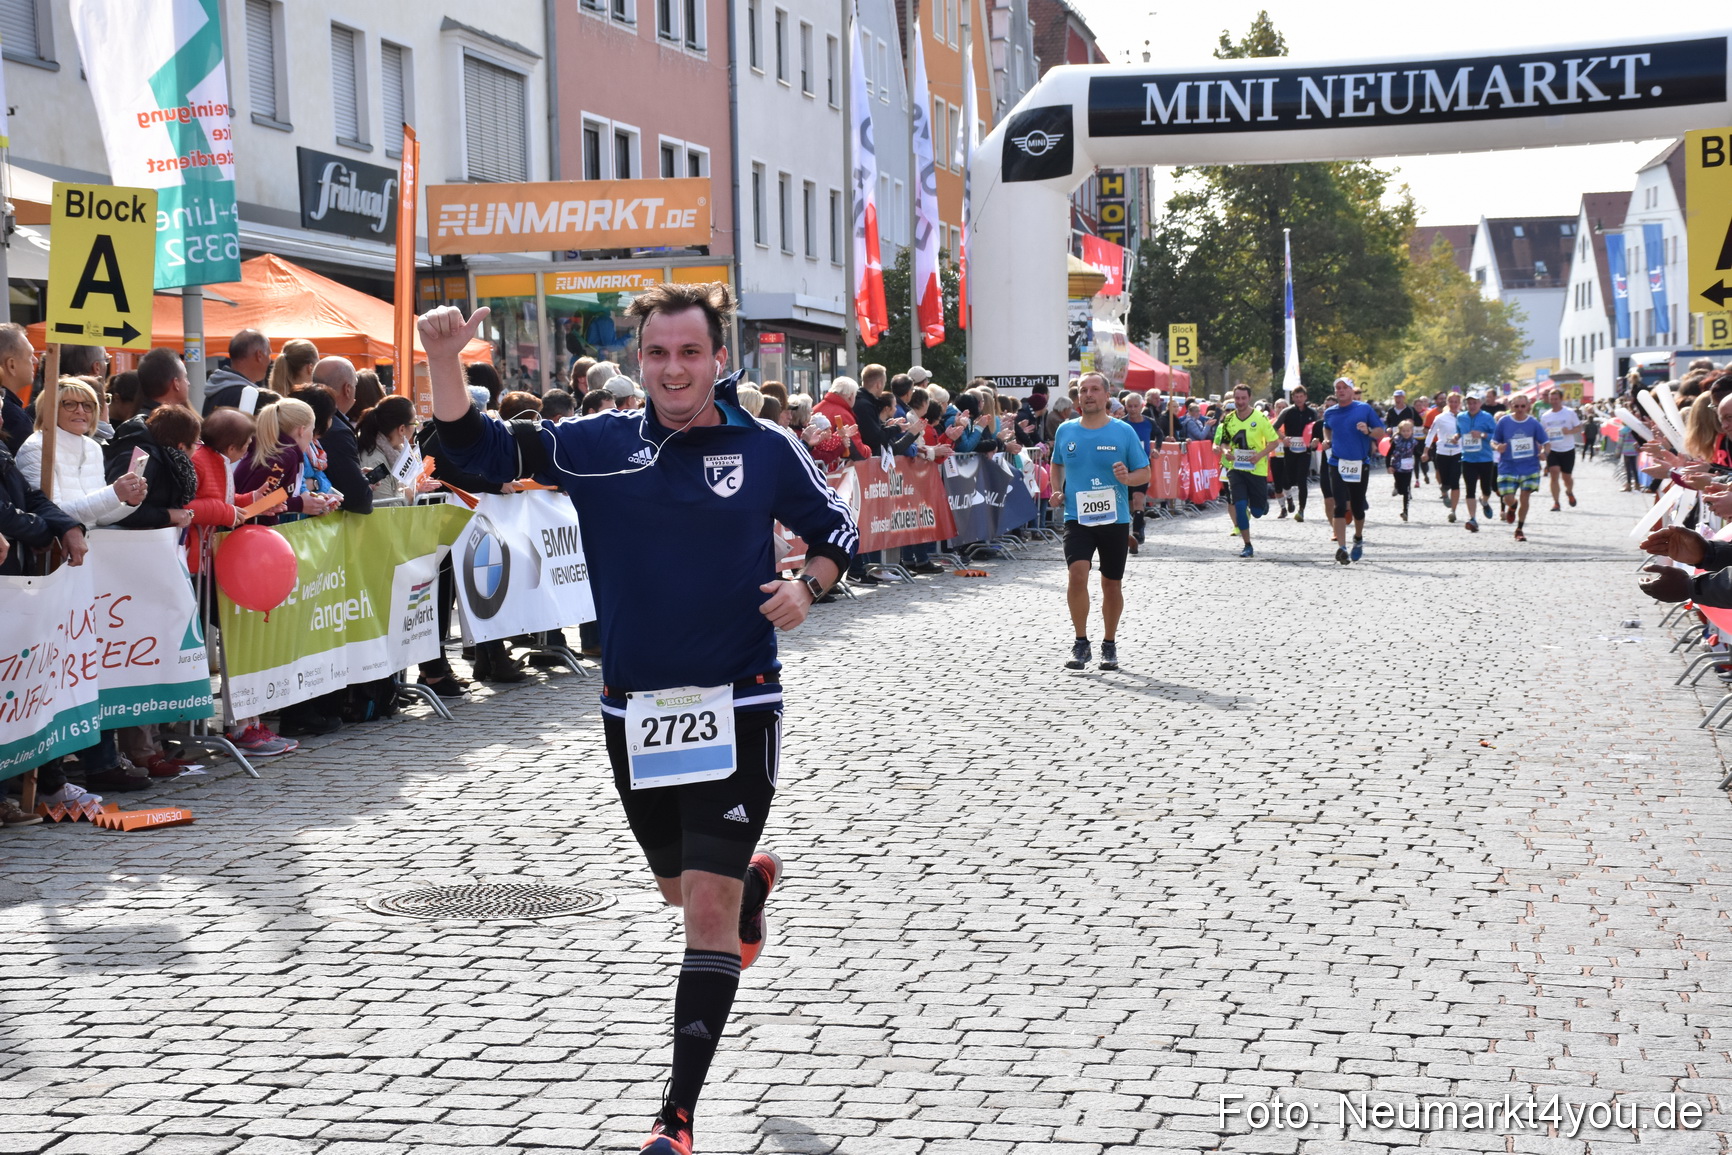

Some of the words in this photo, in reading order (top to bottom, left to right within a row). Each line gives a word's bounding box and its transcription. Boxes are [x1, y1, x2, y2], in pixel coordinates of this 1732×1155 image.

[1141, 78, 1280, 126] MINI
[1296, 52, 1663, 120] NEUMARKT.
[1028, 139, 1046, 147] MINI
[65, 189, 147, 223] Block
[310, 161, 397, 234] frühauf
[438, 198, 697, 237] RUNMARKT.DE
[69, 234, 131, 313] A
[555, 274, 655, 291] RUNMARKT.DE
[1172, 325, 1194, 334] Block
[1711, 318, 1729, 341] B
[1176, 336, 1190, 357] B
[713, 467, 723, 481] F
[1341, 465, 1359, 474] 2149
[726, 476, 737, 490] C
[1091, 478, 1102, 486] 18.
[1083, 500, 1111, 514] 2095
[541, 524, 578, 558] BMW
[550, 562, 589, 586] WENIGER
[666, 694, 702, 706] BOCK
[641, 710, 718, 748] 2723
[723, 813, 750, 824] adidas
[680, 1027, 712, 1040] adidas
